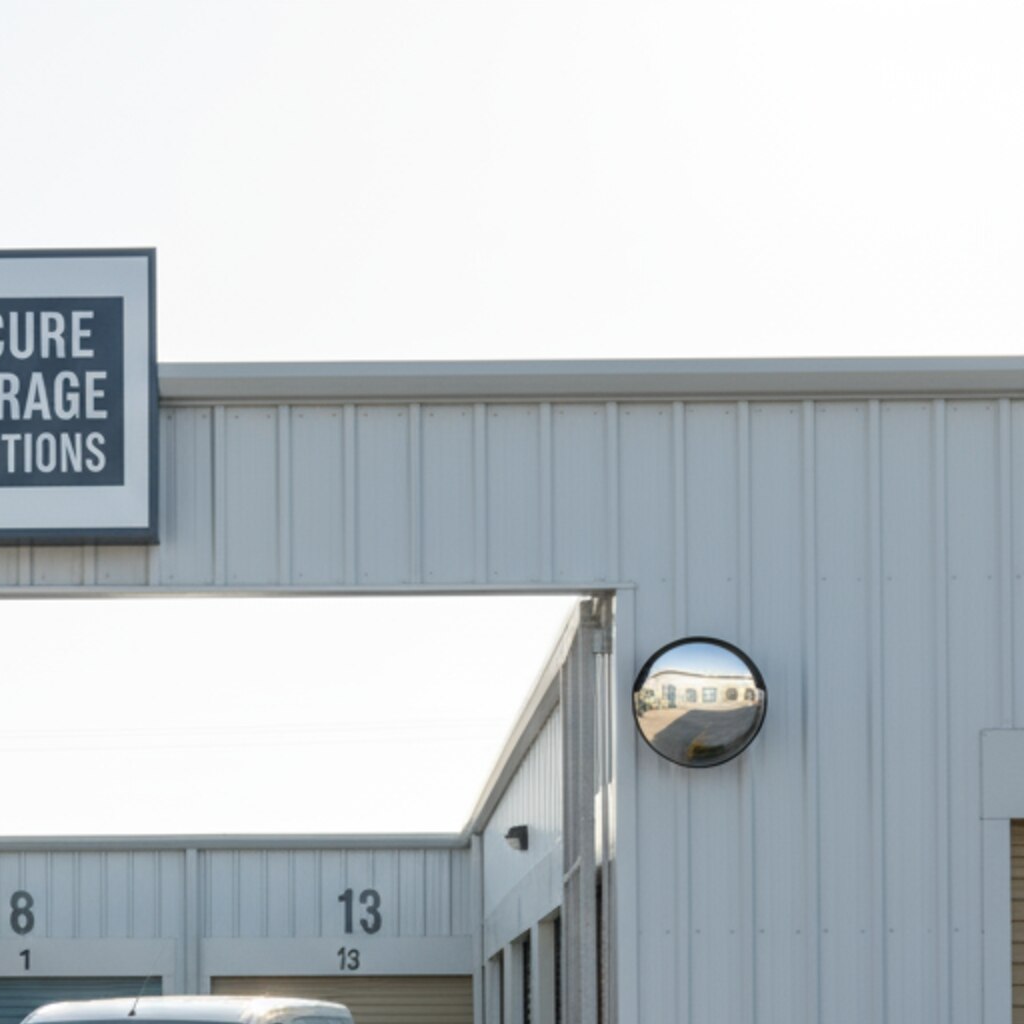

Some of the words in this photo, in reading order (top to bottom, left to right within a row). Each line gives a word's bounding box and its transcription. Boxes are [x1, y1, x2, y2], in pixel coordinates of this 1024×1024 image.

[9, 890, 35, 935] 8
[337, 888, 382, 935] 13
[19, 949, 31, 971] 1
[337, 946, 361, 971] 13
